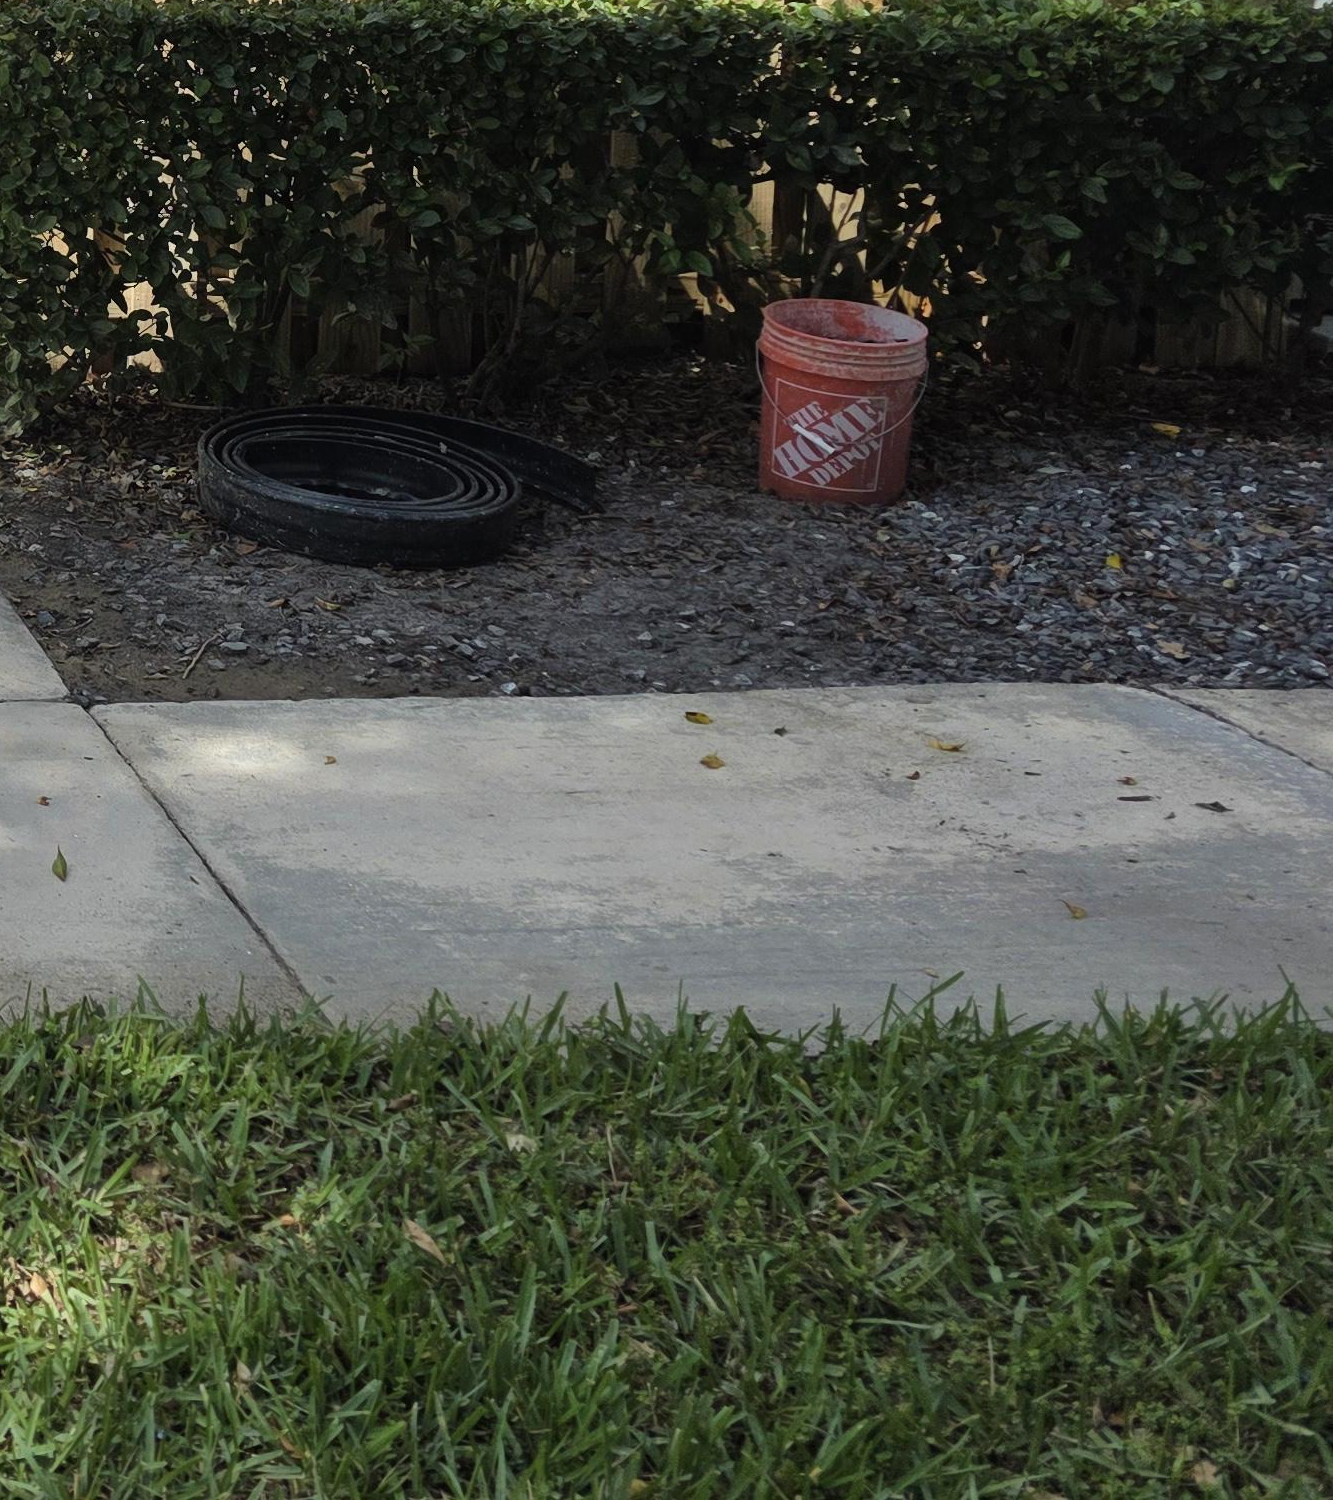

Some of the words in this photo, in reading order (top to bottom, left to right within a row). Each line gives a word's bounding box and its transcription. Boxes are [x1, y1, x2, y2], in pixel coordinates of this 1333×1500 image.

[774, 399, 883, 478] HOME
[783, 401, 829, 433] THE
[808, 432, 881, 486] DEPOT
